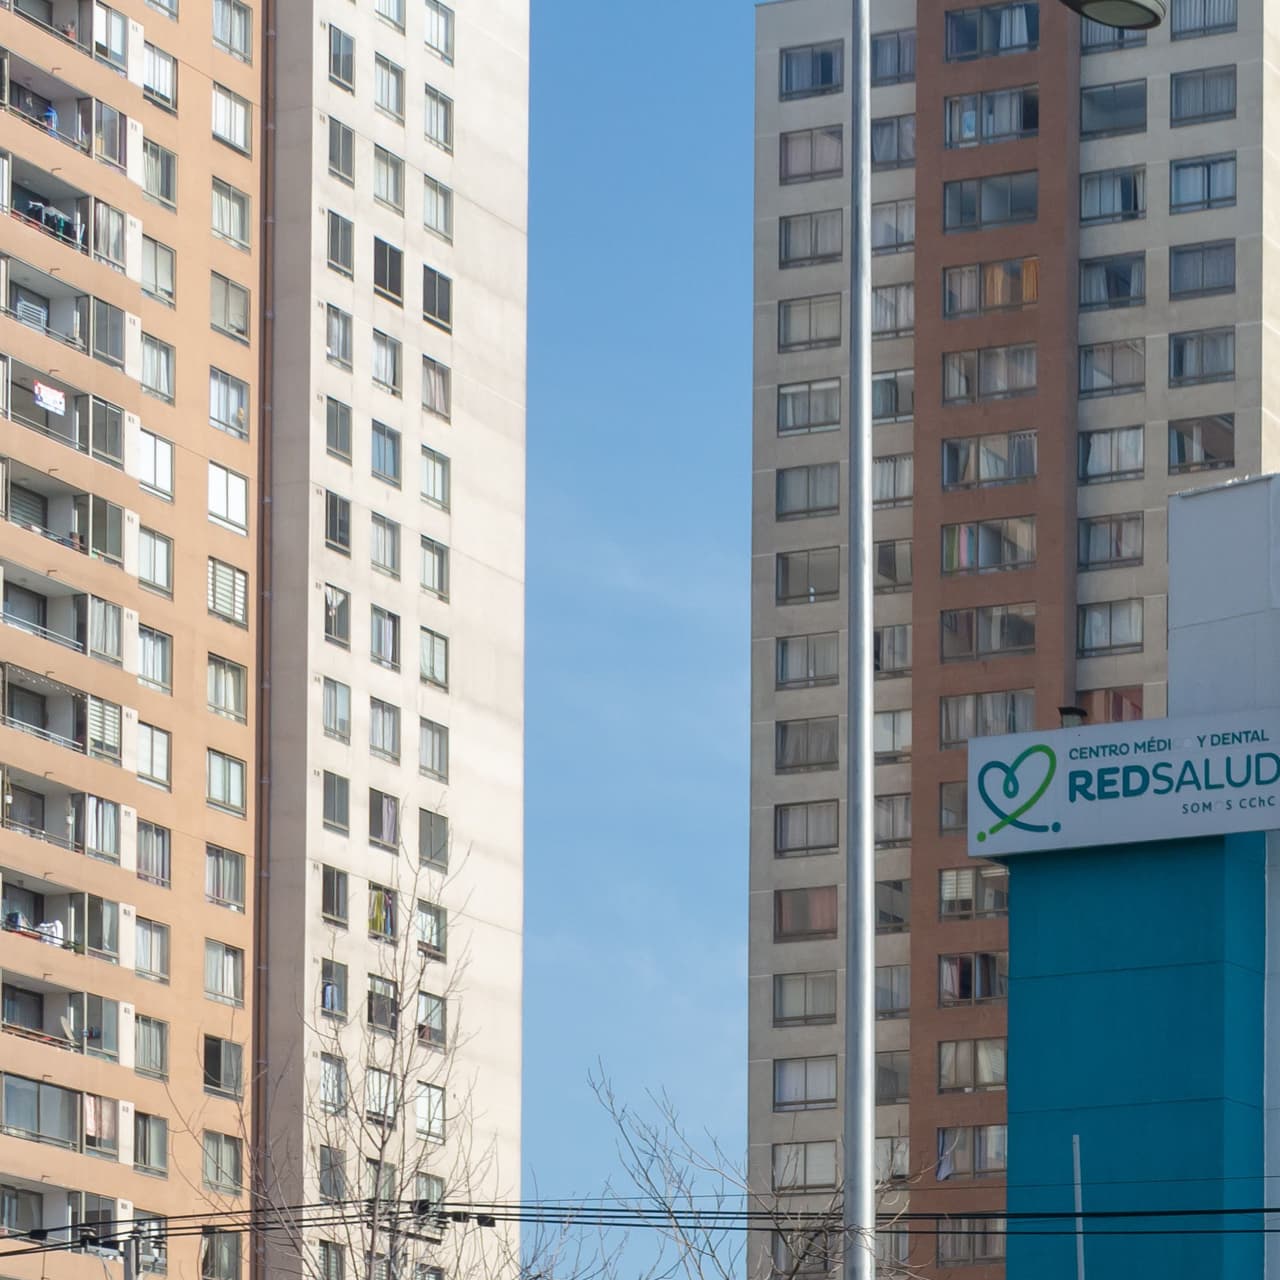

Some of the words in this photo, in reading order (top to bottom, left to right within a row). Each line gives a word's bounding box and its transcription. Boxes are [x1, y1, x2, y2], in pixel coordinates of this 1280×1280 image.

[1069, 743, 1130, 761] CENTRO
[1134, 736, 1193, 755] MÉDI
[1197, 735, 1207, 748] Y
[1210, 729, 1269, 747] DENTAL
[1182, 799, 1233, 814] SOMS
[1239, 795, 1277, 809] CChC
